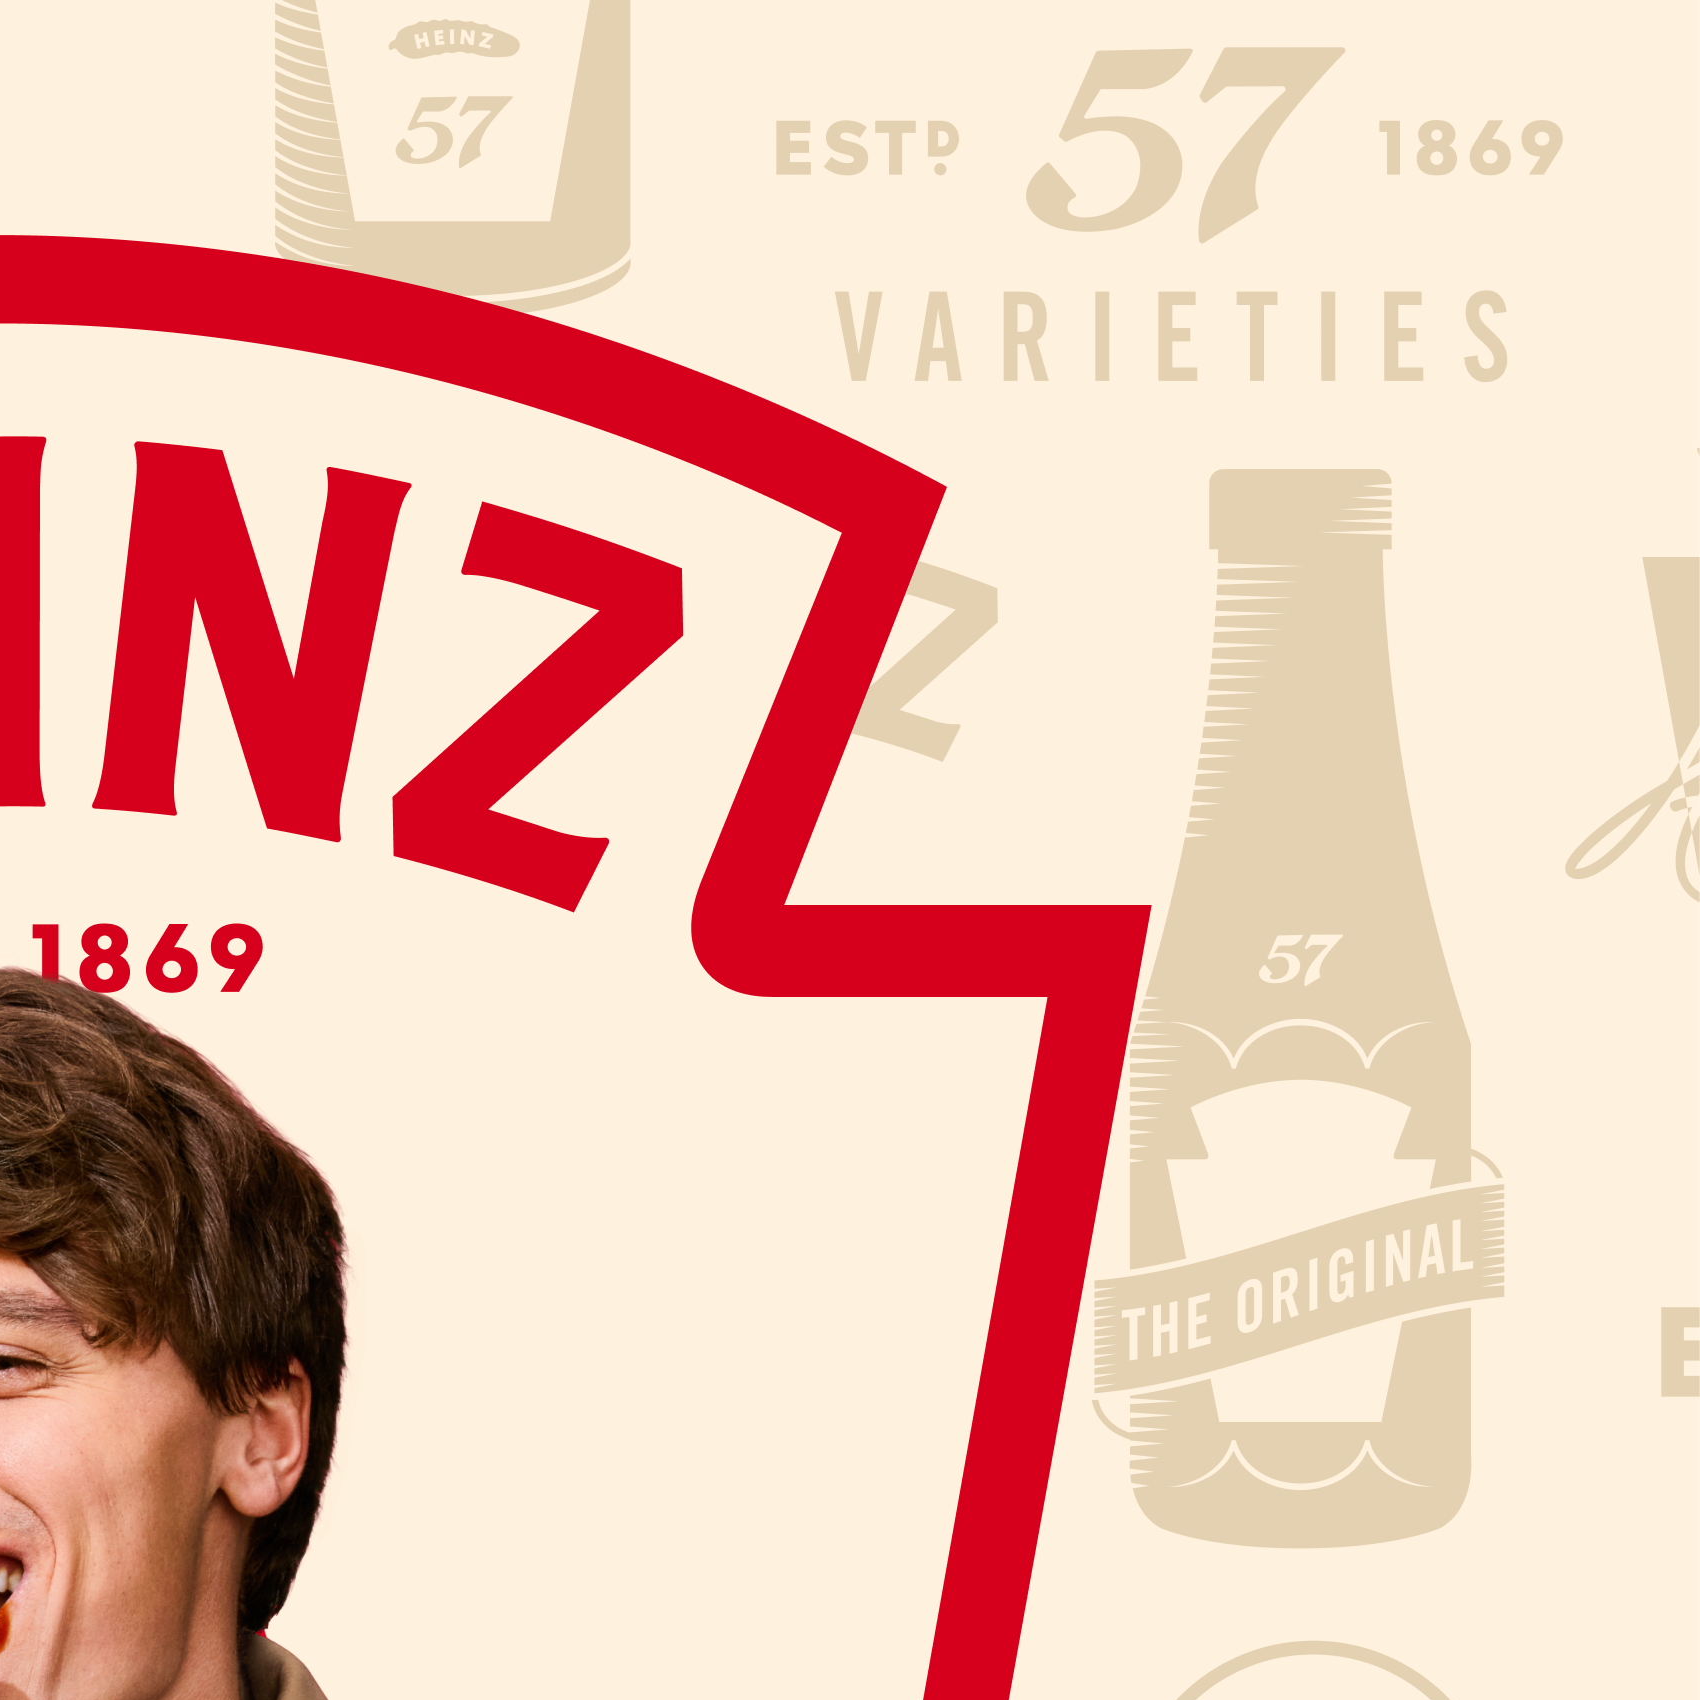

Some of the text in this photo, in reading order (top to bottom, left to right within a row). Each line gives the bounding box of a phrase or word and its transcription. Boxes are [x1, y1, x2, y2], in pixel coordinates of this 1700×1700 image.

[415, 30, 493, 49] HEINZ
[396, 96, 512, 168] 57
[1026, 48, 1345, 243] 57
[1380, 120, 1563, 175] 1869
[835, 291, 1507, 382] VARIETIES
[33, 924, 262, 992] 1869
[1259, 935, 1343, 986] 57
[1122, 1220, 1473, 1360] THE ORIGINAL
